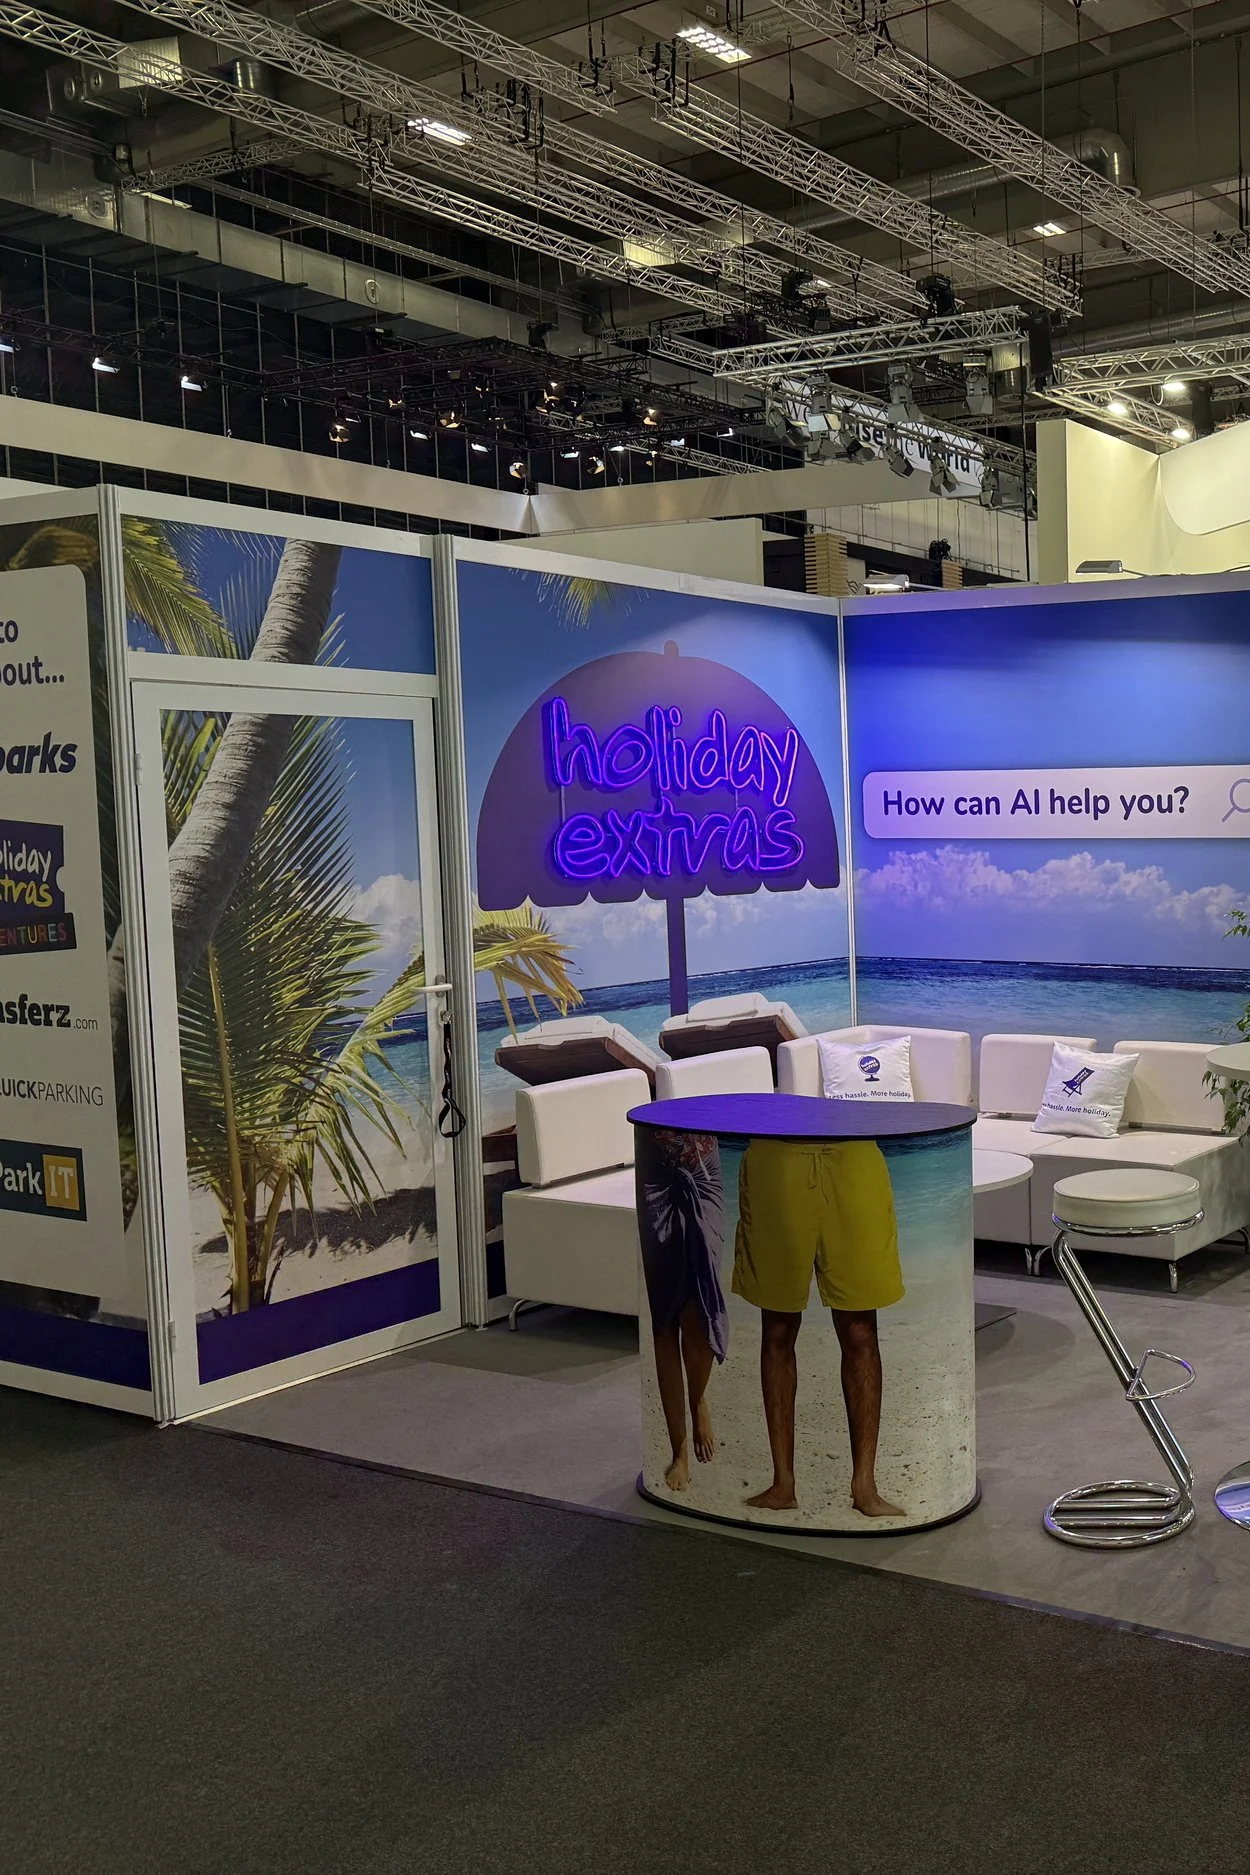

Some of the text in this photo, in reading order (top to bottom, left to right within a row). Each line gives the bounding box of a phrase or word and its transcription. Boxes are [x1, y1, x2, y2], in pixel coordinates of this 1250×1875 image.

[0, 655, 65, 687] out...
[0, 730, 78, 775] arks
[549, 696, 799, 807] holiday
[883, 785, 1190, 821] How can AI help you?
[554, 795, 805, 879] extras
[0, 839, 52, 882] liday
[845, 1090, 869, 1099] hassle.
[1066, 1105, 1082, 1113] More
[1083, 1107, 1111, 1118] holiday.
